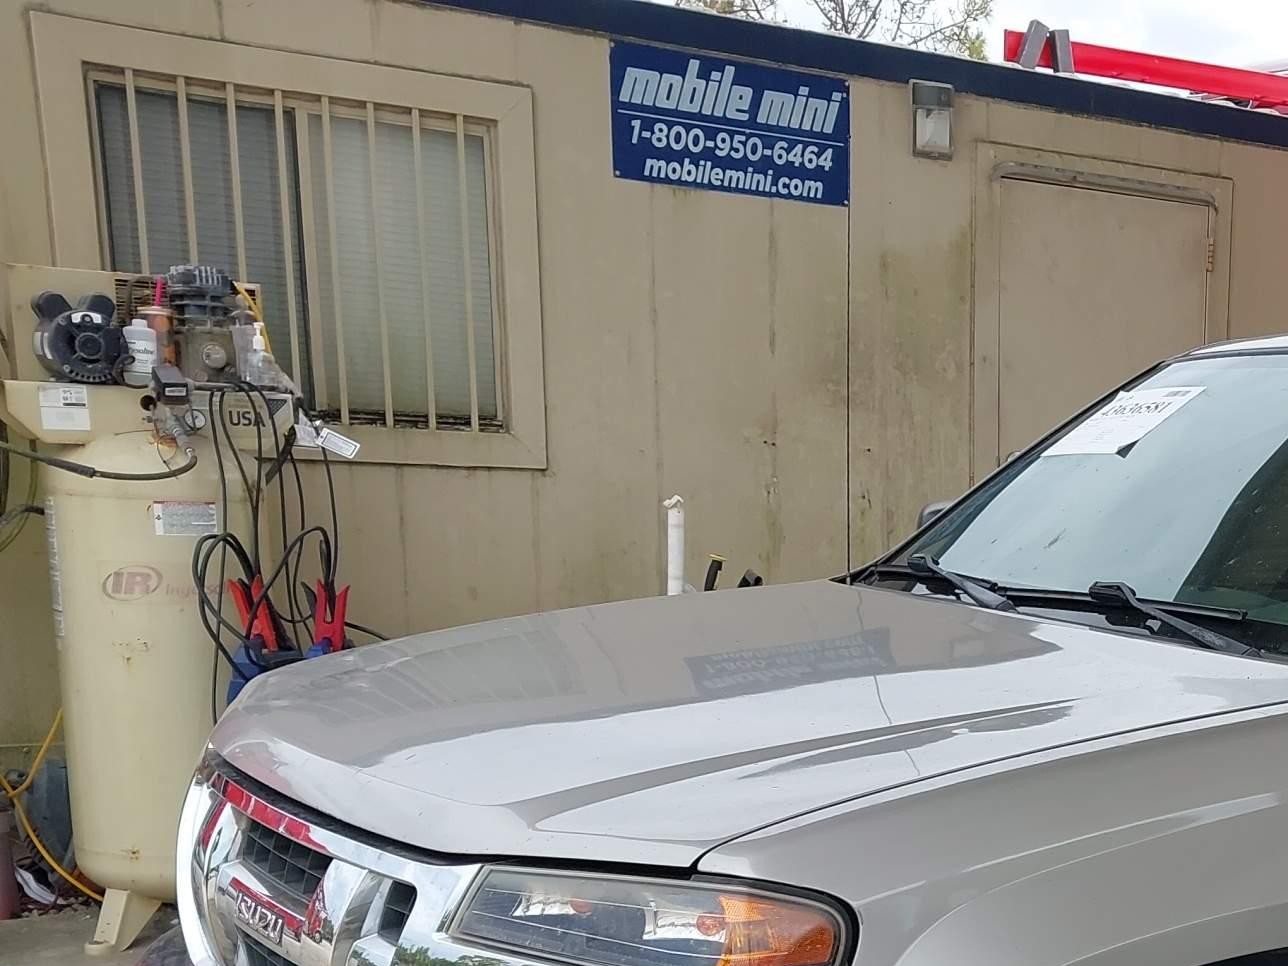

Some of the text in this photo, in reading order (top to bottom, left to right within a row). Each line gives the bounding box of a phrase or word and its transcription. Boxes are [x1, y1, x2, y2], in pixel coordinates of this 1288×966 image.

[618, 58, 843, 134] mobile mini
[630, 119, 833, 171] 1-800-950-6464
[643, 157, 824, 199] mobilemini.com
[228, 410, 267, 428] USA
[236, 892, 284, 944] ISUZU
